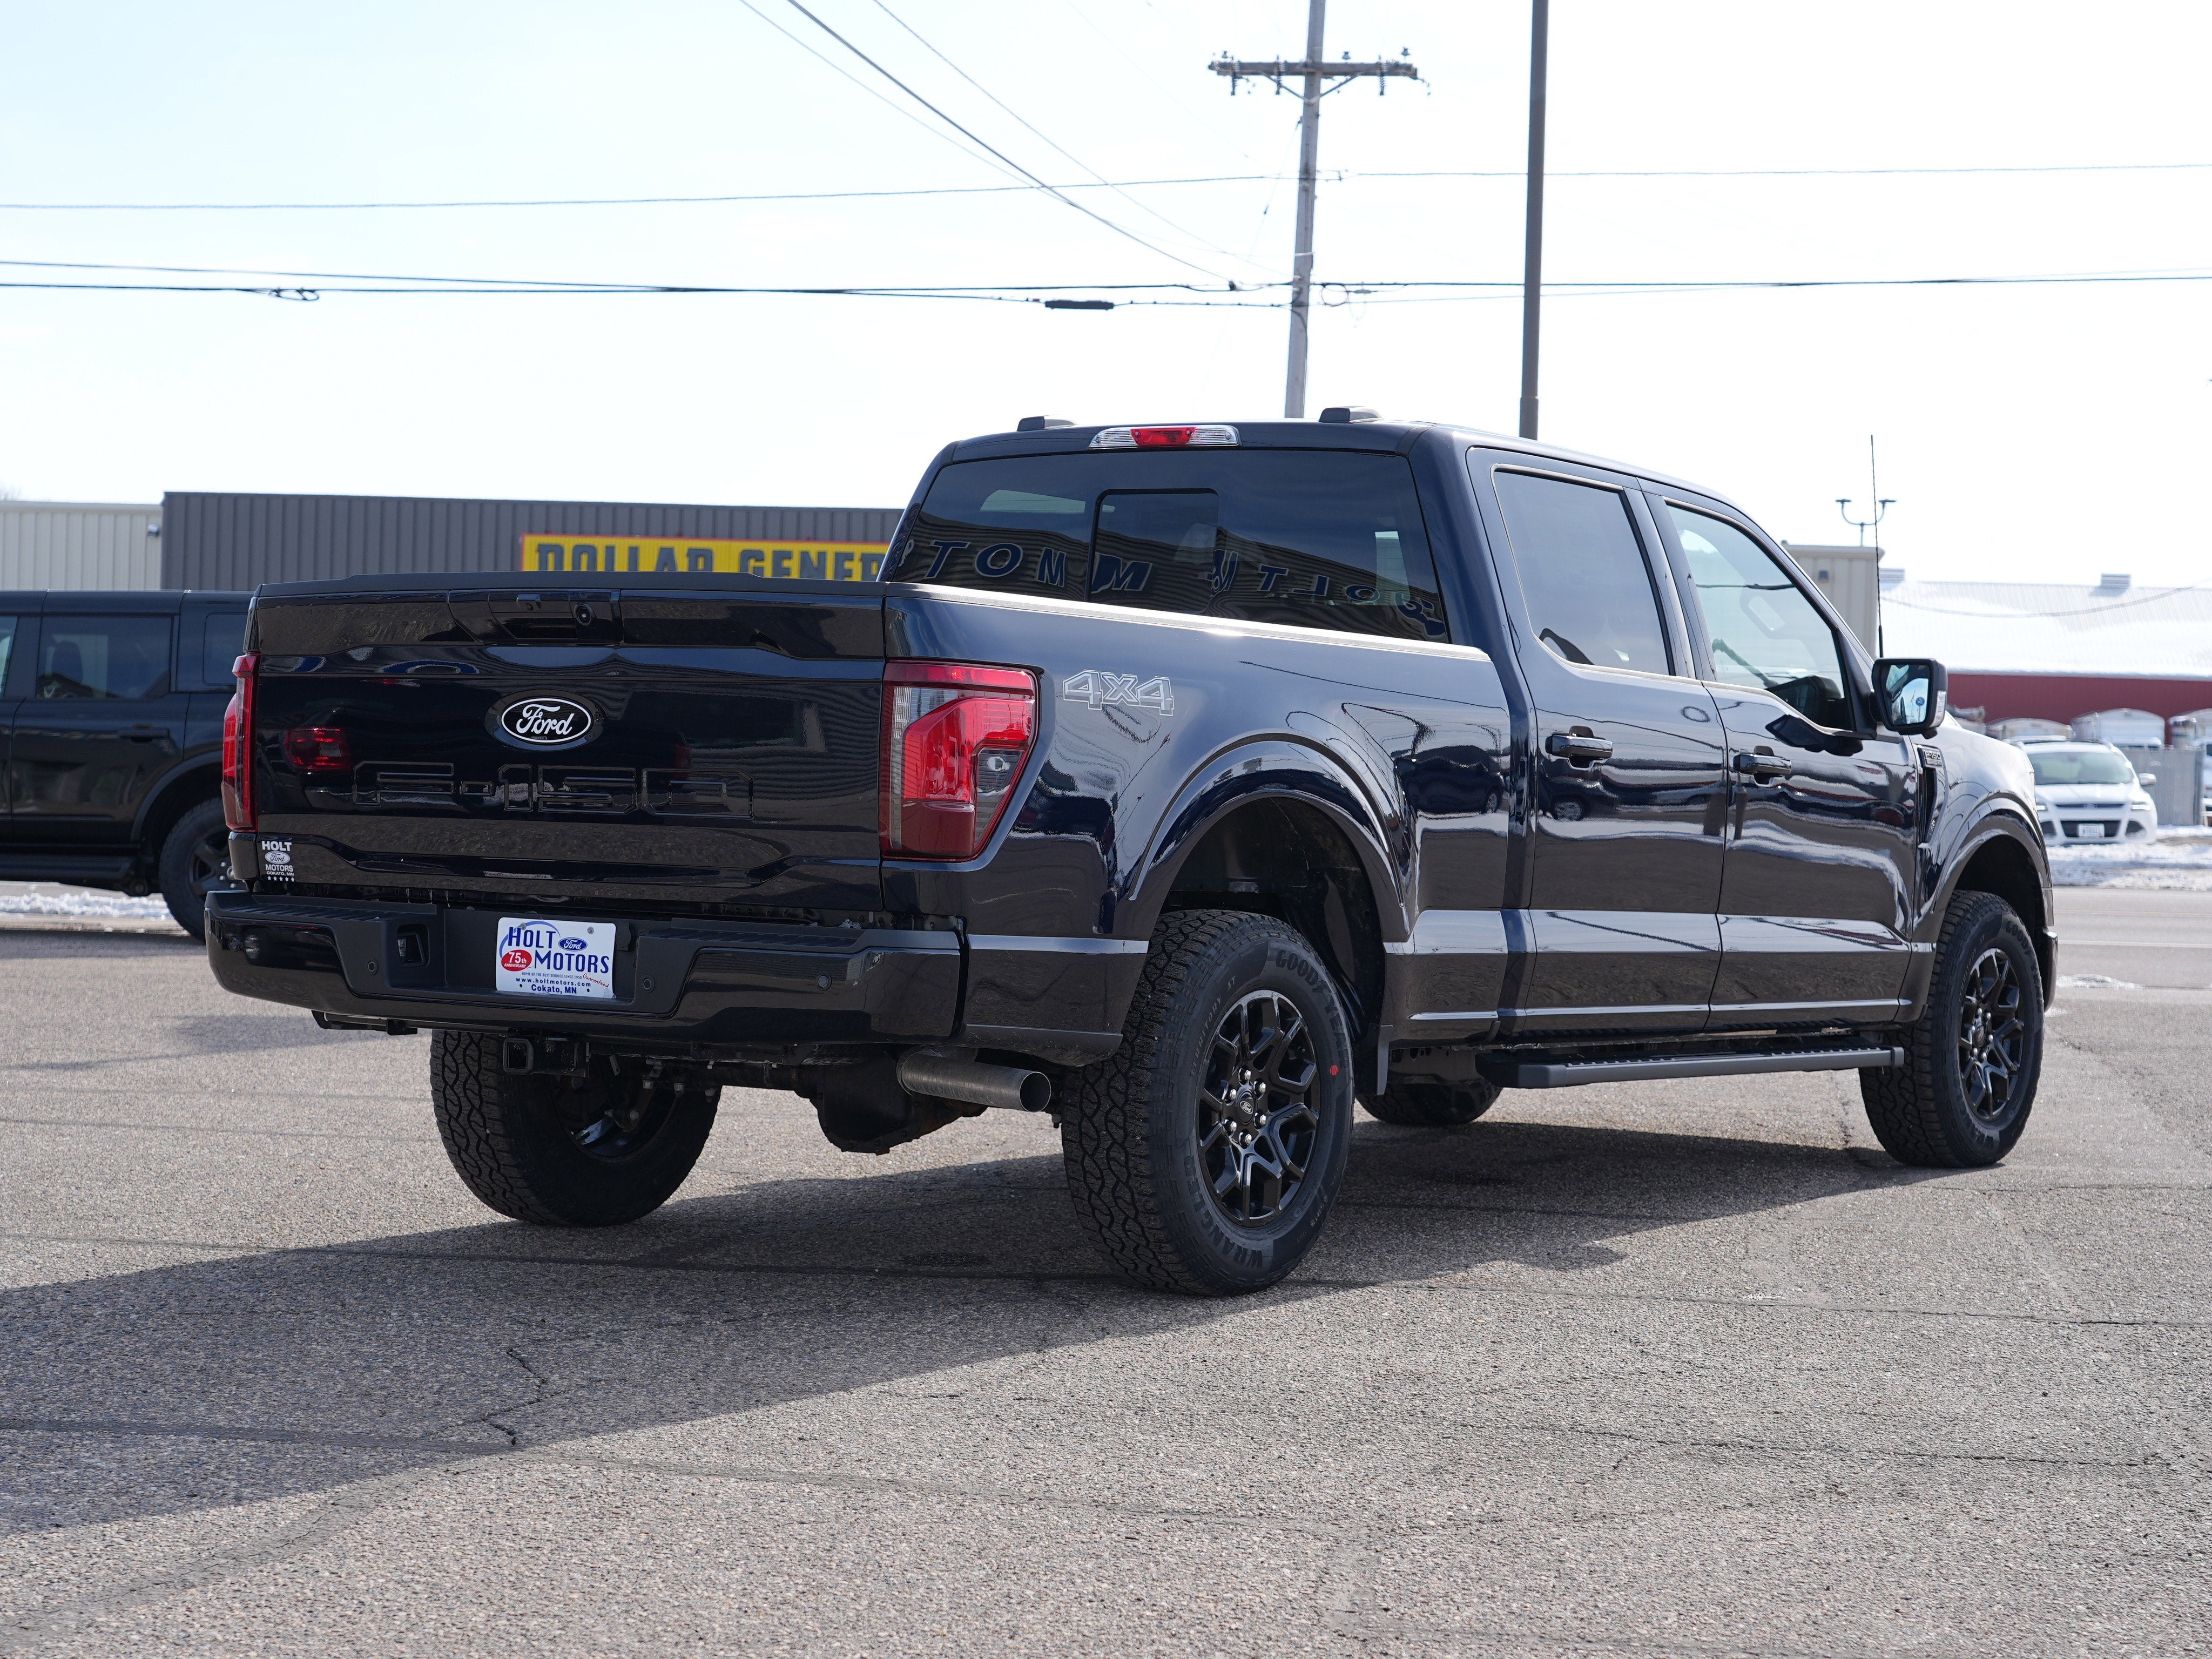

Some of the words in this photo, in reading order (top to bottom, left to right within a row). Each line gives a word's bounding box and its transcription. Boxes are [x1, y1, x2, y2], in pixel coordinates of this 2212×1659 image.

[516, 703, 575, 735] Ford
[352, 760, 754, 819] F-150
[261, 840, 292, 852] HOLT
[270, 853, 285, 862] Ford
[265, 864, 294, 872] MOTORS
[508, 926, 556, 949] HOLT
[563, 938, 582, 950] Ford
[509, 952, 527, 964] 75th
[534, 949, 609, 974] MOTORS
[516, 977, 591, 987] www.holtmotors.com
[583, 973, 610, 988] Guaranteed
[531, 984, 563, 995] Cokato,
[1276, 948, 1350, 1069] GOODYEAR
[1190, 994, 1222, 1077] TERRITORY
[1227, 975, 1236, 992] AT
[1184, 1155, 1264, 1269] WRANGLER
